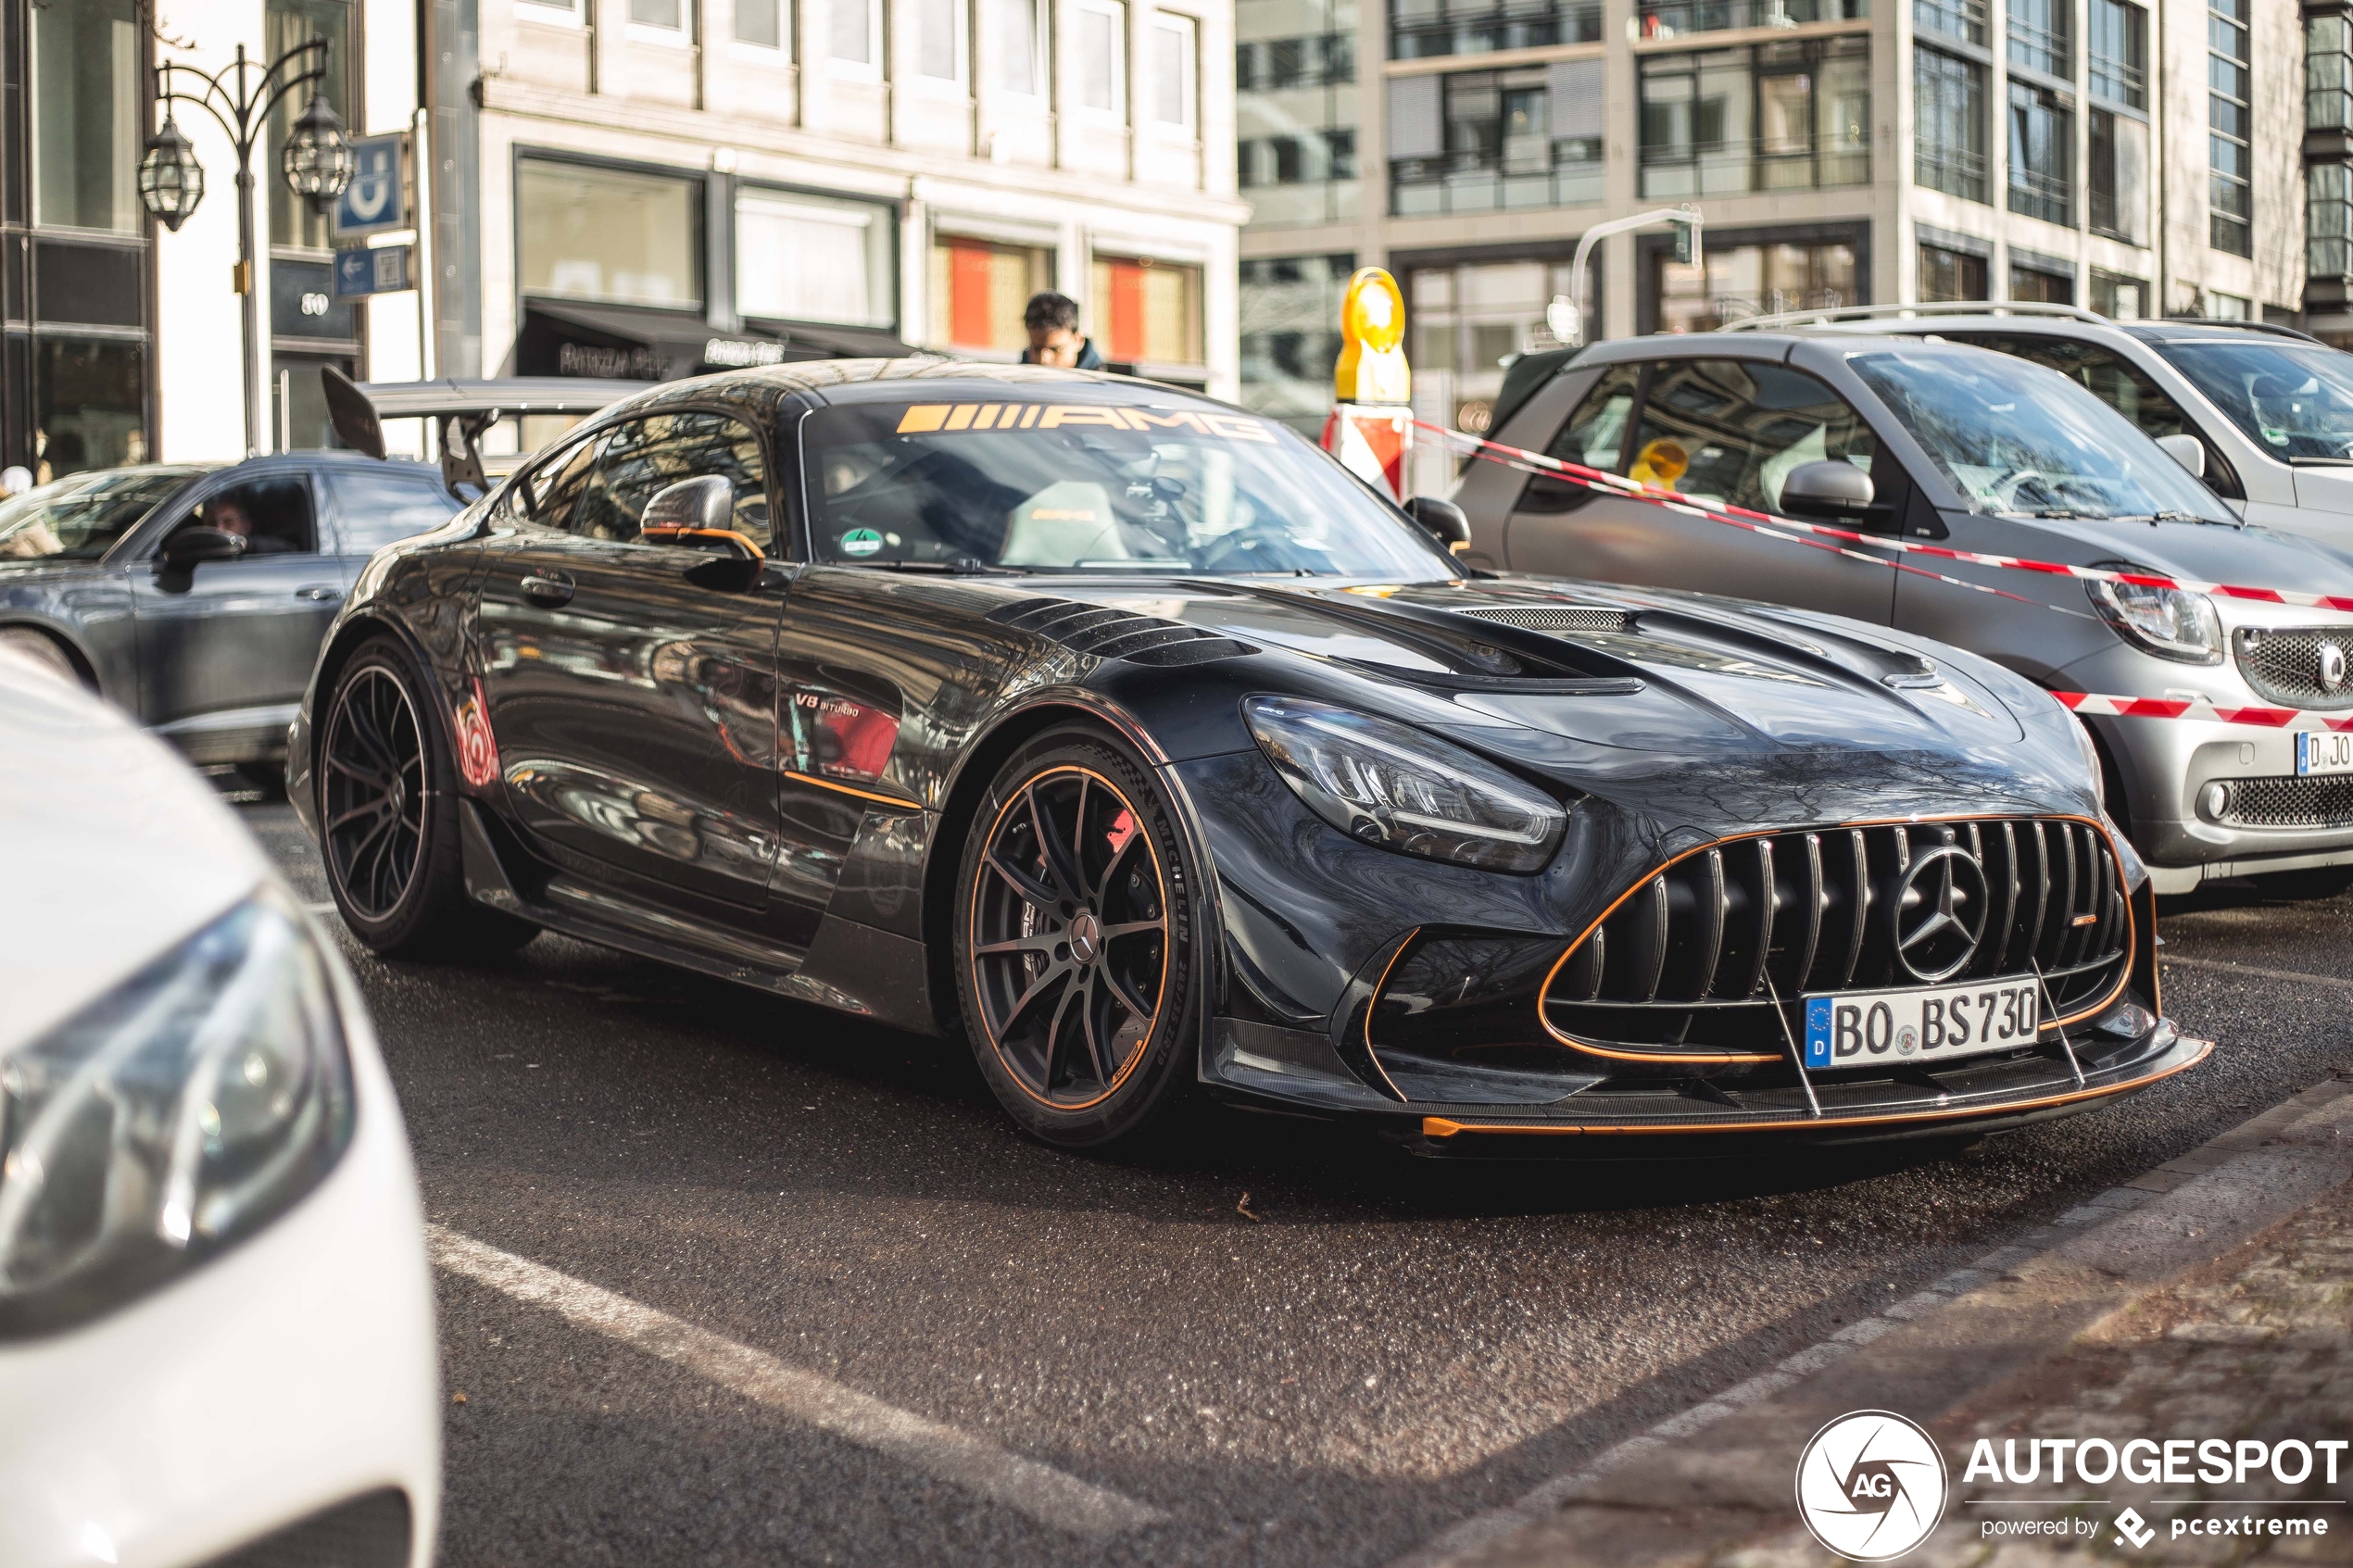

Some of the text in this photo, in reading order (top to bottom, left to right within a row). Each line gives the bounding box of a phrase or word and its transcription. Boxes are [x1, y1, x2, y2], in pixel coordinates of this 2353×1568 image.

[347, 150, 389, 221] U
[856, 529, 868, 542] 4
[796, 693, 819, 709] V8
[820, 702, 860, 718] BITURBO
[2310, 737, 2320, 767] D
[1157, 819, 1189, 943] MICHELIN
[1171, 960, 1188, 1024] 285/35
[1835, 986, 2036, 1058] BO BS 730
[1814, 1040, 1825, 1056] D
